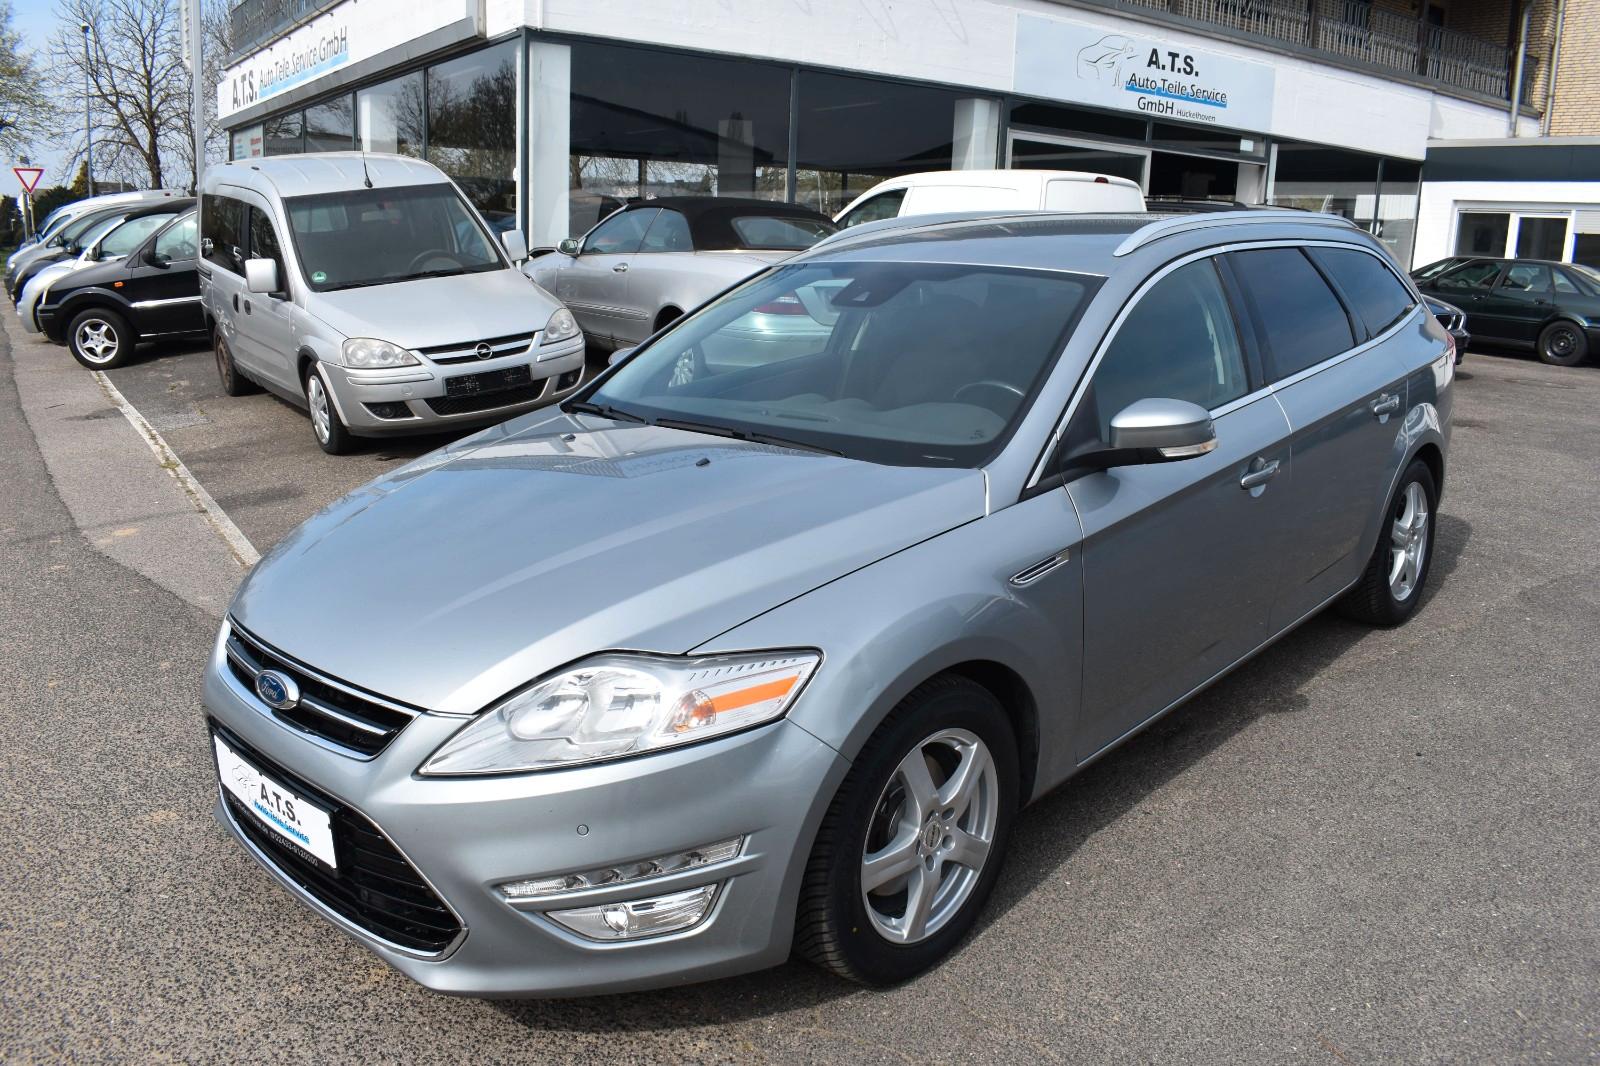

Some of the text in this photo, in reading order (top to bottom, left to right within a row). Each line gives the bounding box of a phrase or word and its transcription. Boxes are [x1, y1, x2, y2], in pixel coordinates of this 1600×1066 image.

[232, 70, 258, 110] A.T.S.
[259, 68, 273, 88] Auto
[291, 46, 318, 75] Service
[319, 26, 348, 62] GmbH
[1147, 48, 1199, 77] A.T.S.
[1127, 72, 1227, 103] Auto Teile Service
[1137, 96, 1174, 115] GmbH
[260, 782, 301, 826] A.T.S.
